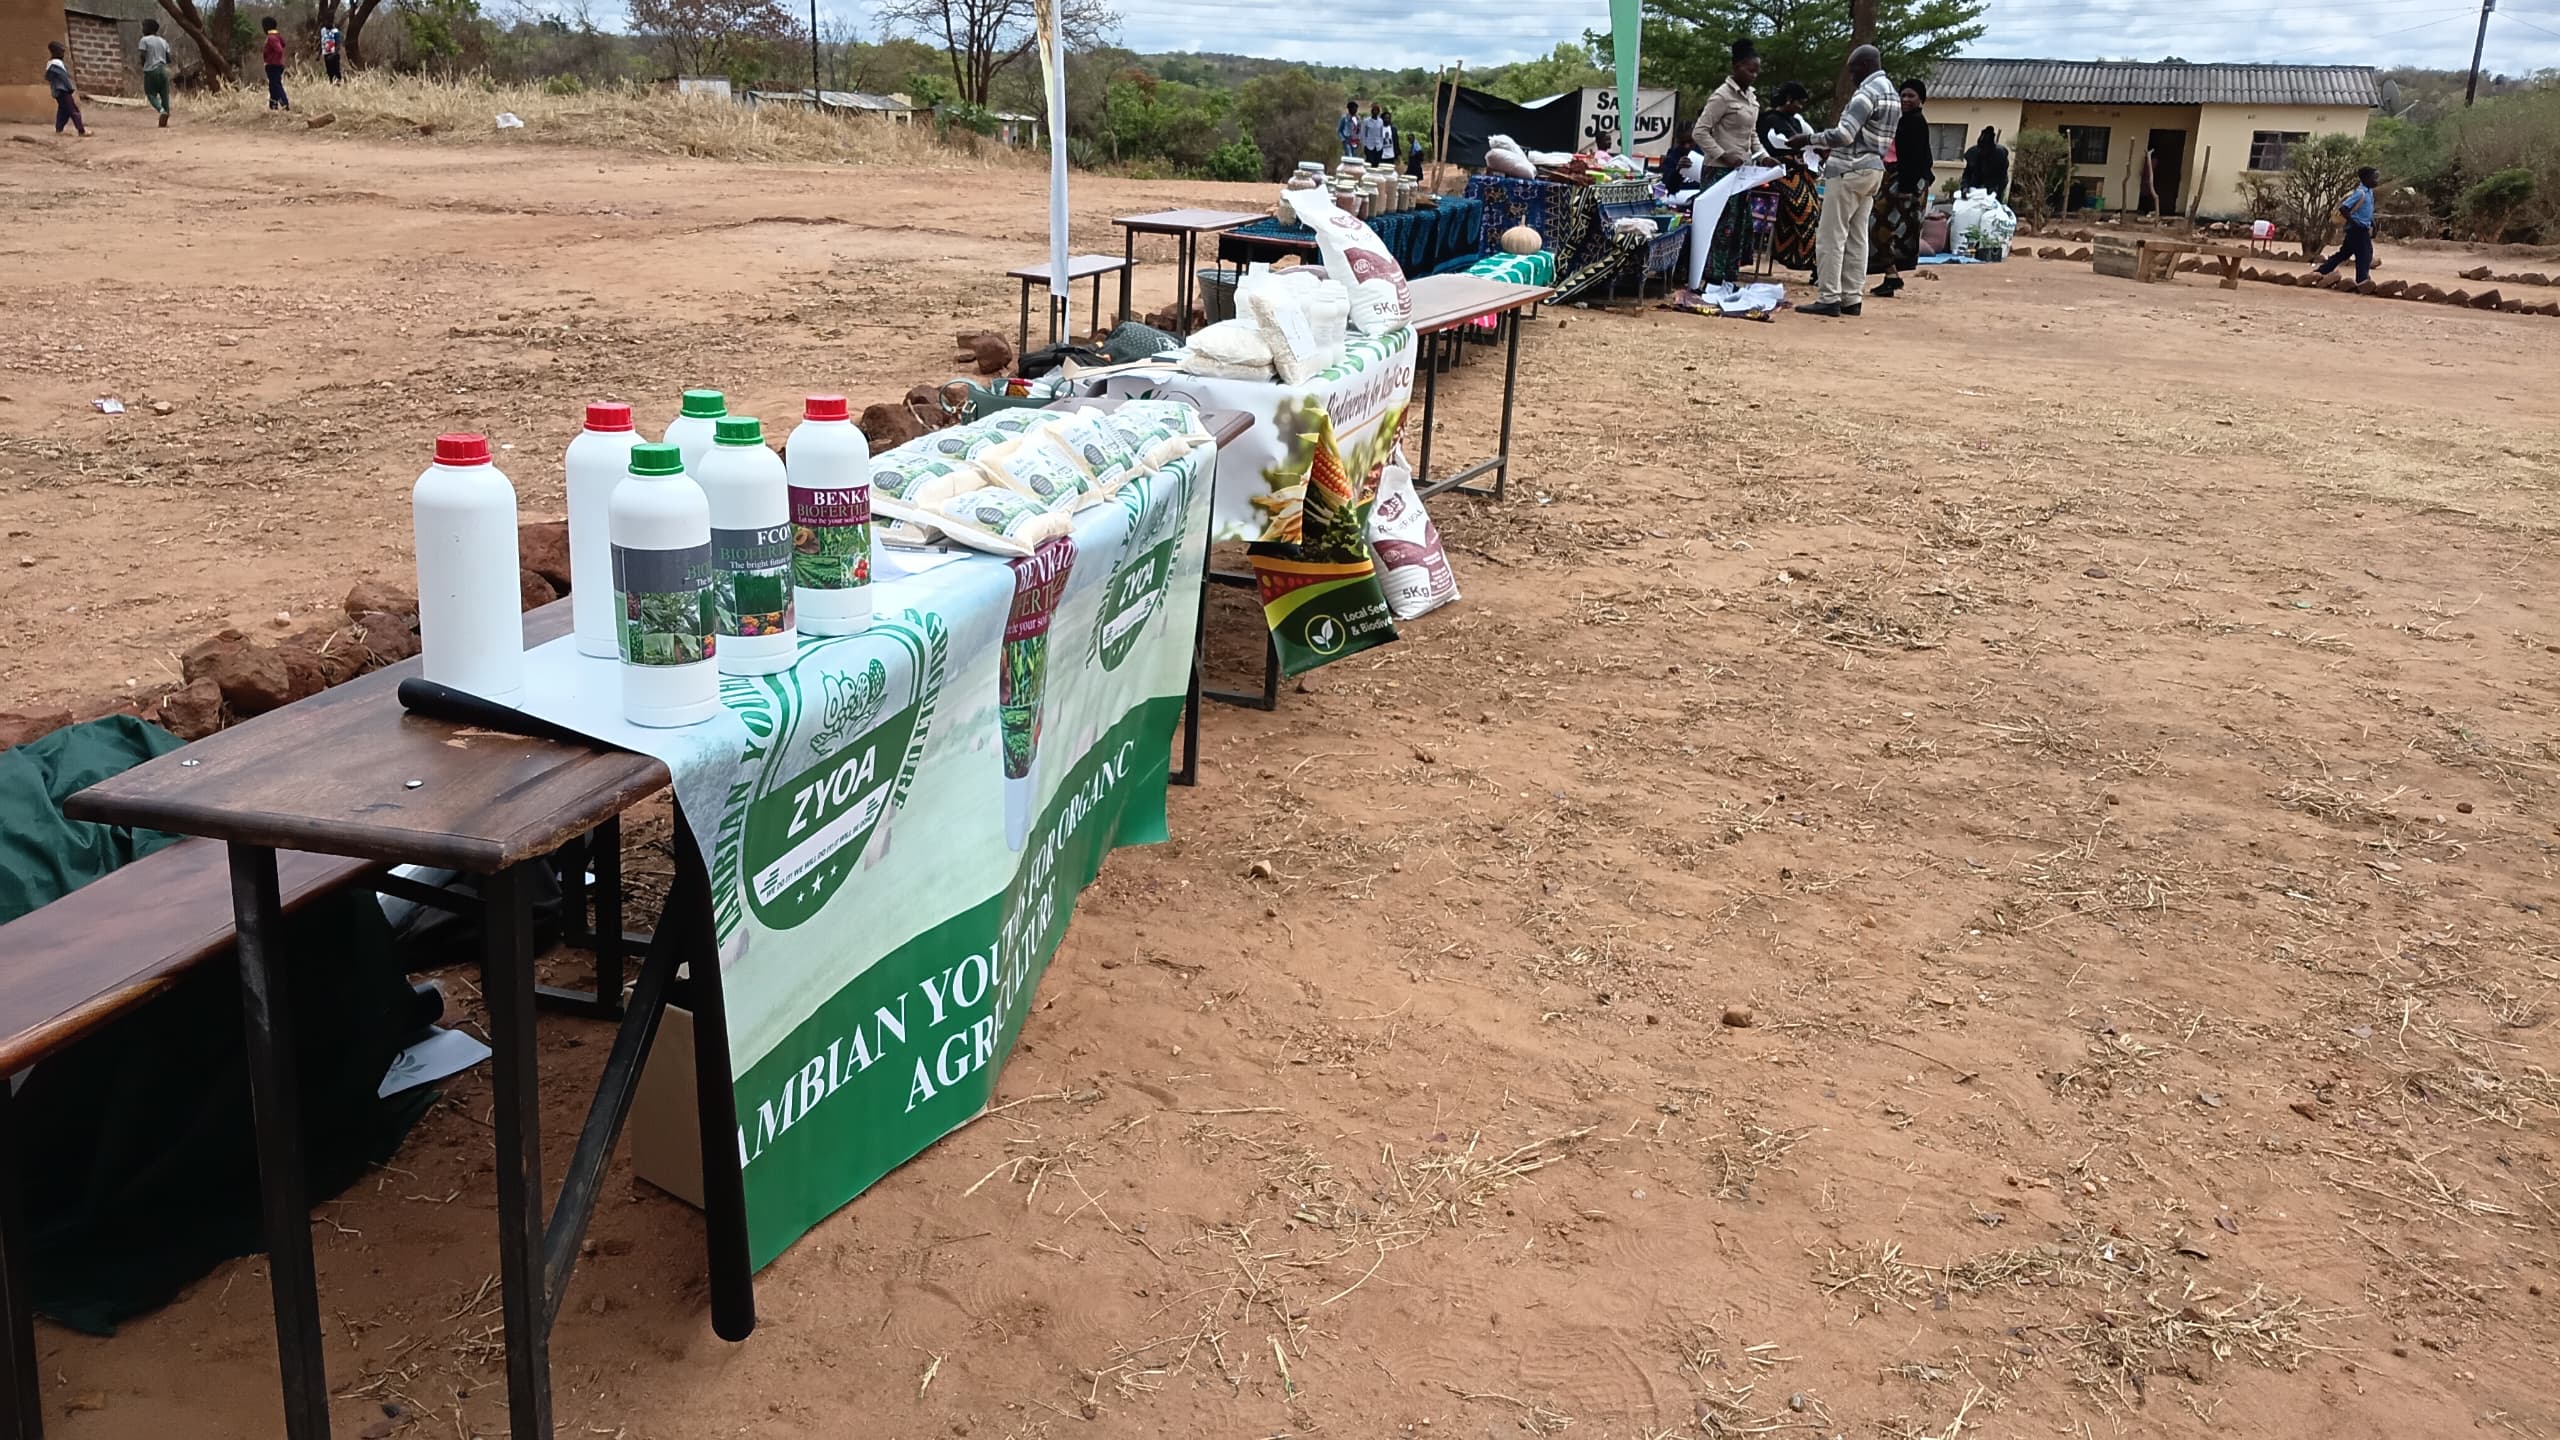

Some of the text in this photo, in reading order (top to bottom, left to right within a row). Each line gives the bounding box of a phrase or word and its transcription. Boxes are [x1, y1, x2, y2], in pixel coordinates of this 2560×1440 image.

[1374, 302, 1399, 316] 5Kg
[729, 560, 745, 569] The
[747, 559, 769, 570] bright
[1402, 586, 1430, 599] 5Kg
[1343, 607, 1369, 623] Local
[1351, 625, 1360, 636] &
[787, 745, 877, 839] ZYOA
[1027, 828, 1055, 909] FOR
[1057, 740, 1134, 850] ORGANC
[904, 874, 1056, 1114] AGRICULTURE
